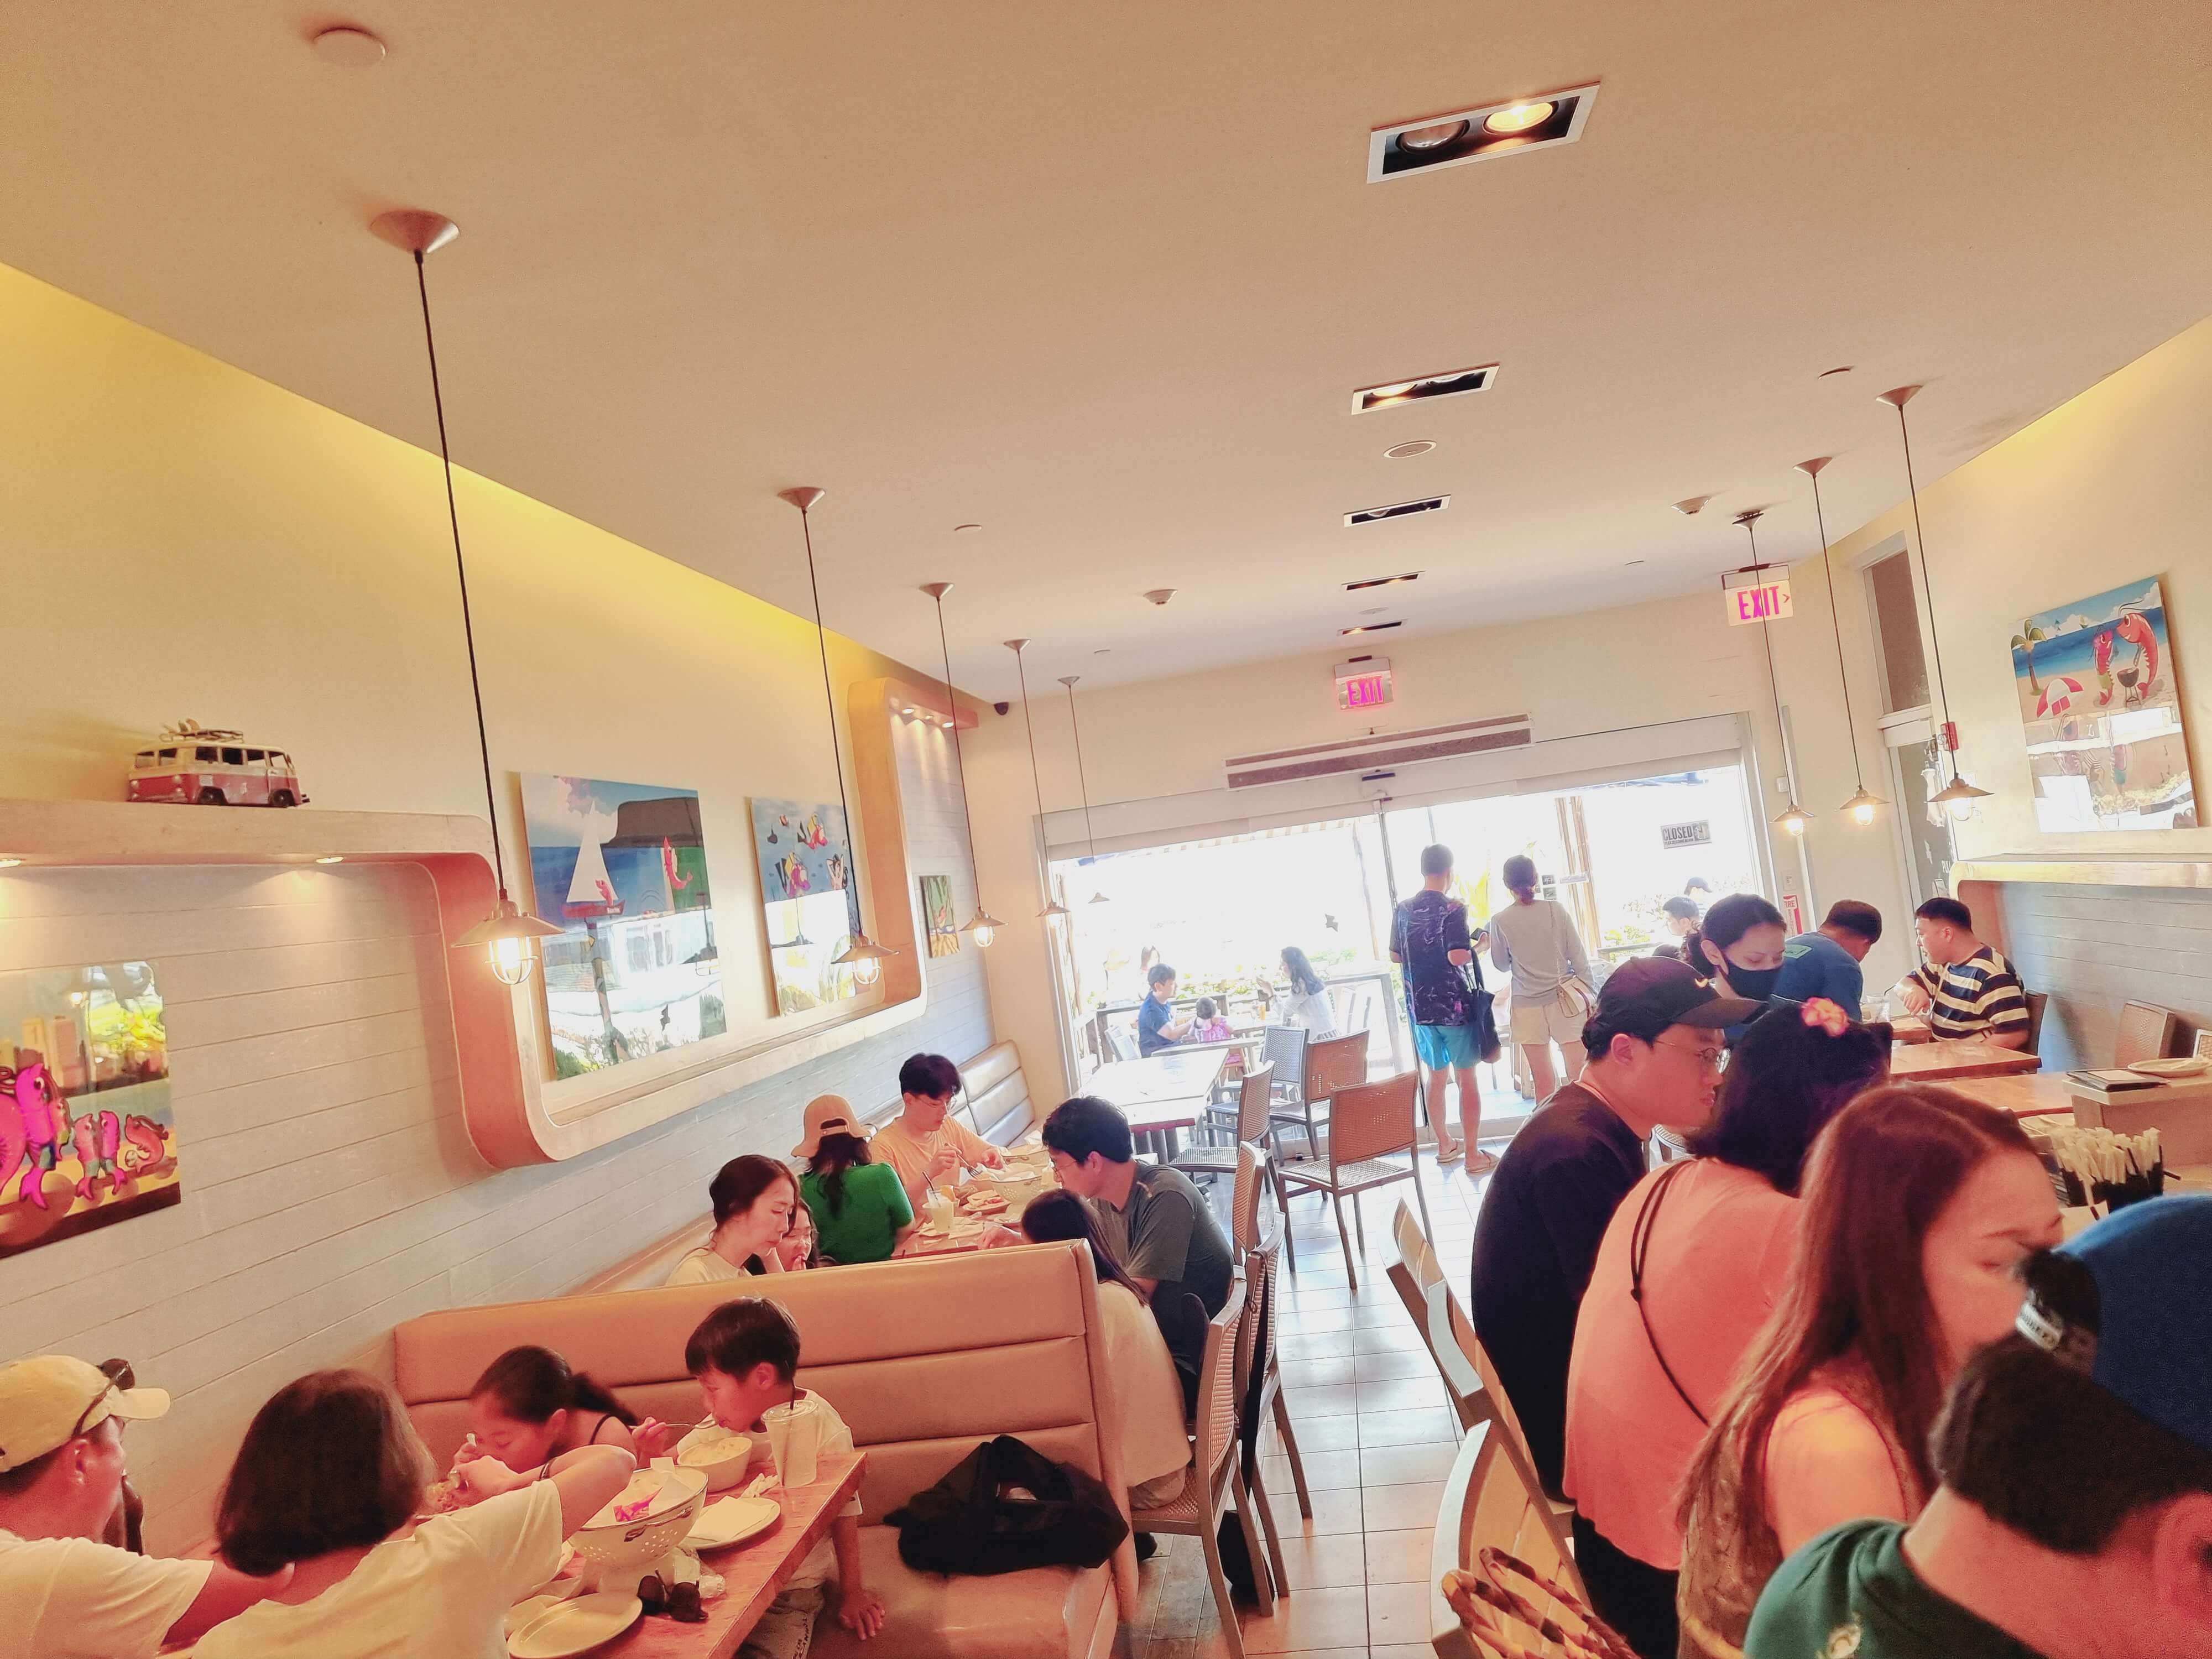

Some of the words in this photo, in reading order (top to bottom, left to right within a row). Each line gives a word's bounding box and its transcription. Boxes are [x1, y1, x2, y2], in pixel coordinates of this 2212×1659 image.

[1737, 586, 1780, 620] EXIT
[1345, 676, 1383, 706] EXIT
[1663, 826, 1693, 841] CLOSED
